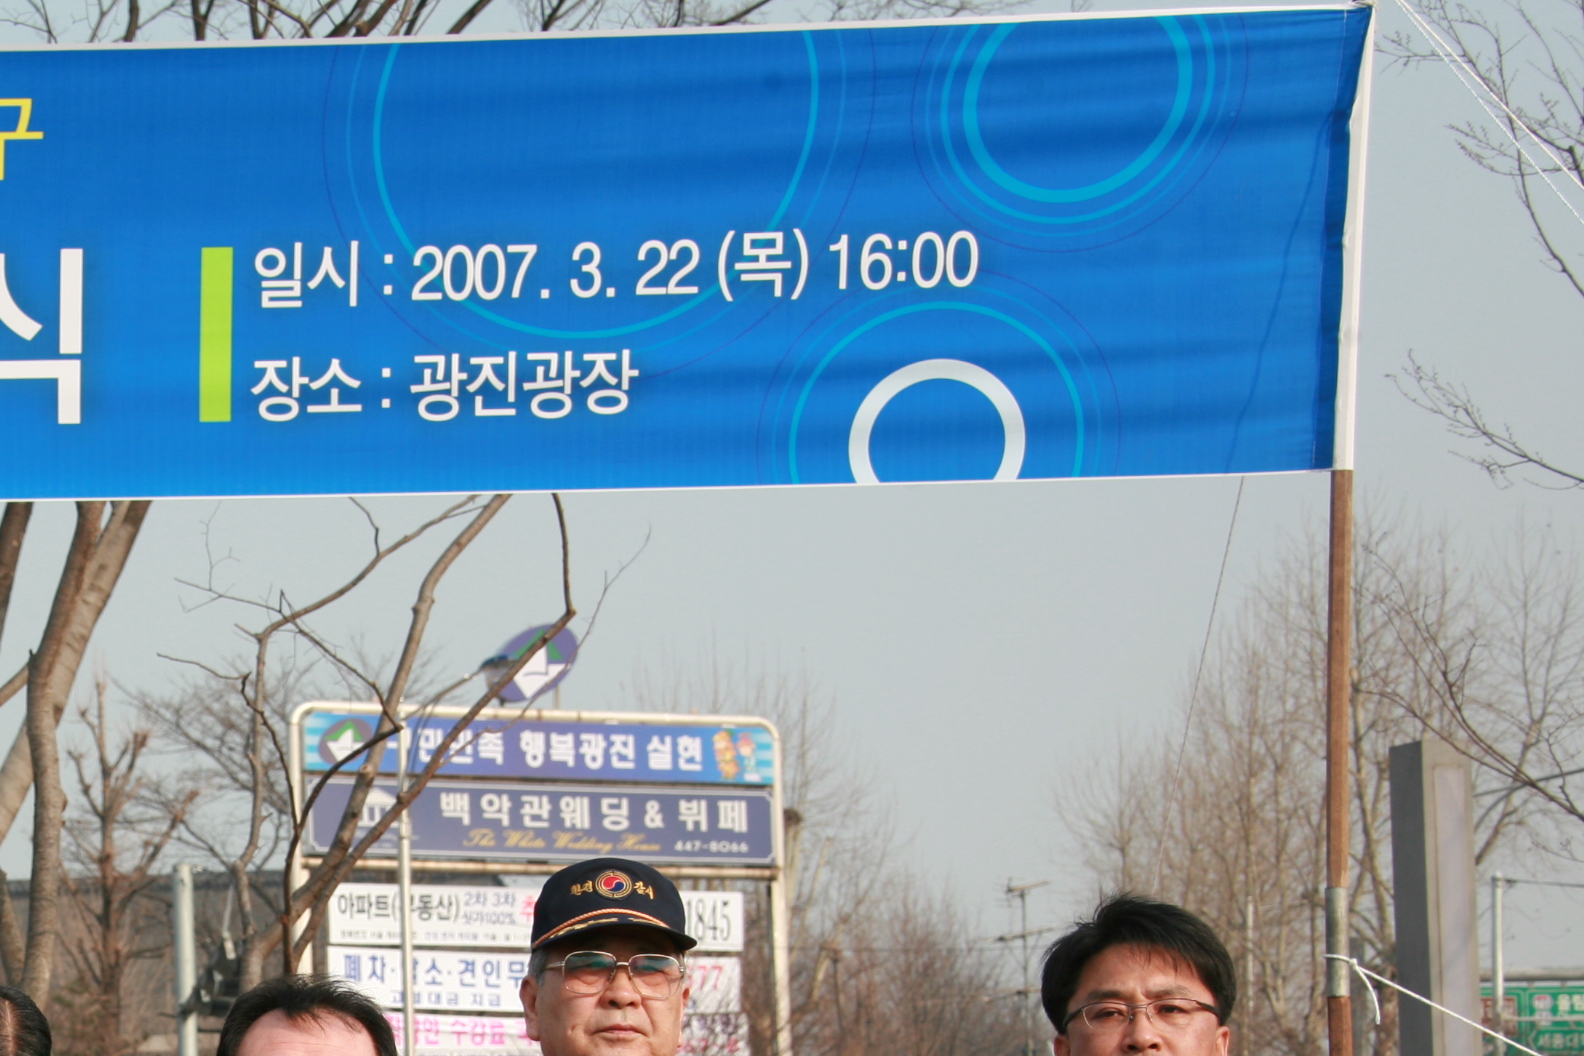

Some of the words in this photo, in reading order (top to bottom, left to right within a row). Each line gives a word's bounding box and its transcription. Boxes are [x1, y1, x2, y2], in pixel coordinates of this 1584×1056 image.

[255, 241, 358, 307] 일시
[412, 244, 549, 300] 2007.
[571, 242, 615, 297] 3.
[636, 239, 699, 294] 22
[719, 229, 808, 301] (목)
[830, 231, 978, 289] 16:00
[252, 357, 362, 421] 장소
[411, 349, 639, 421] 광진광장
[519, 731, 636, 770] 행복광진
[647, 735, 703, 771] 실현
[678, 799, 748, 833] 뷔페
